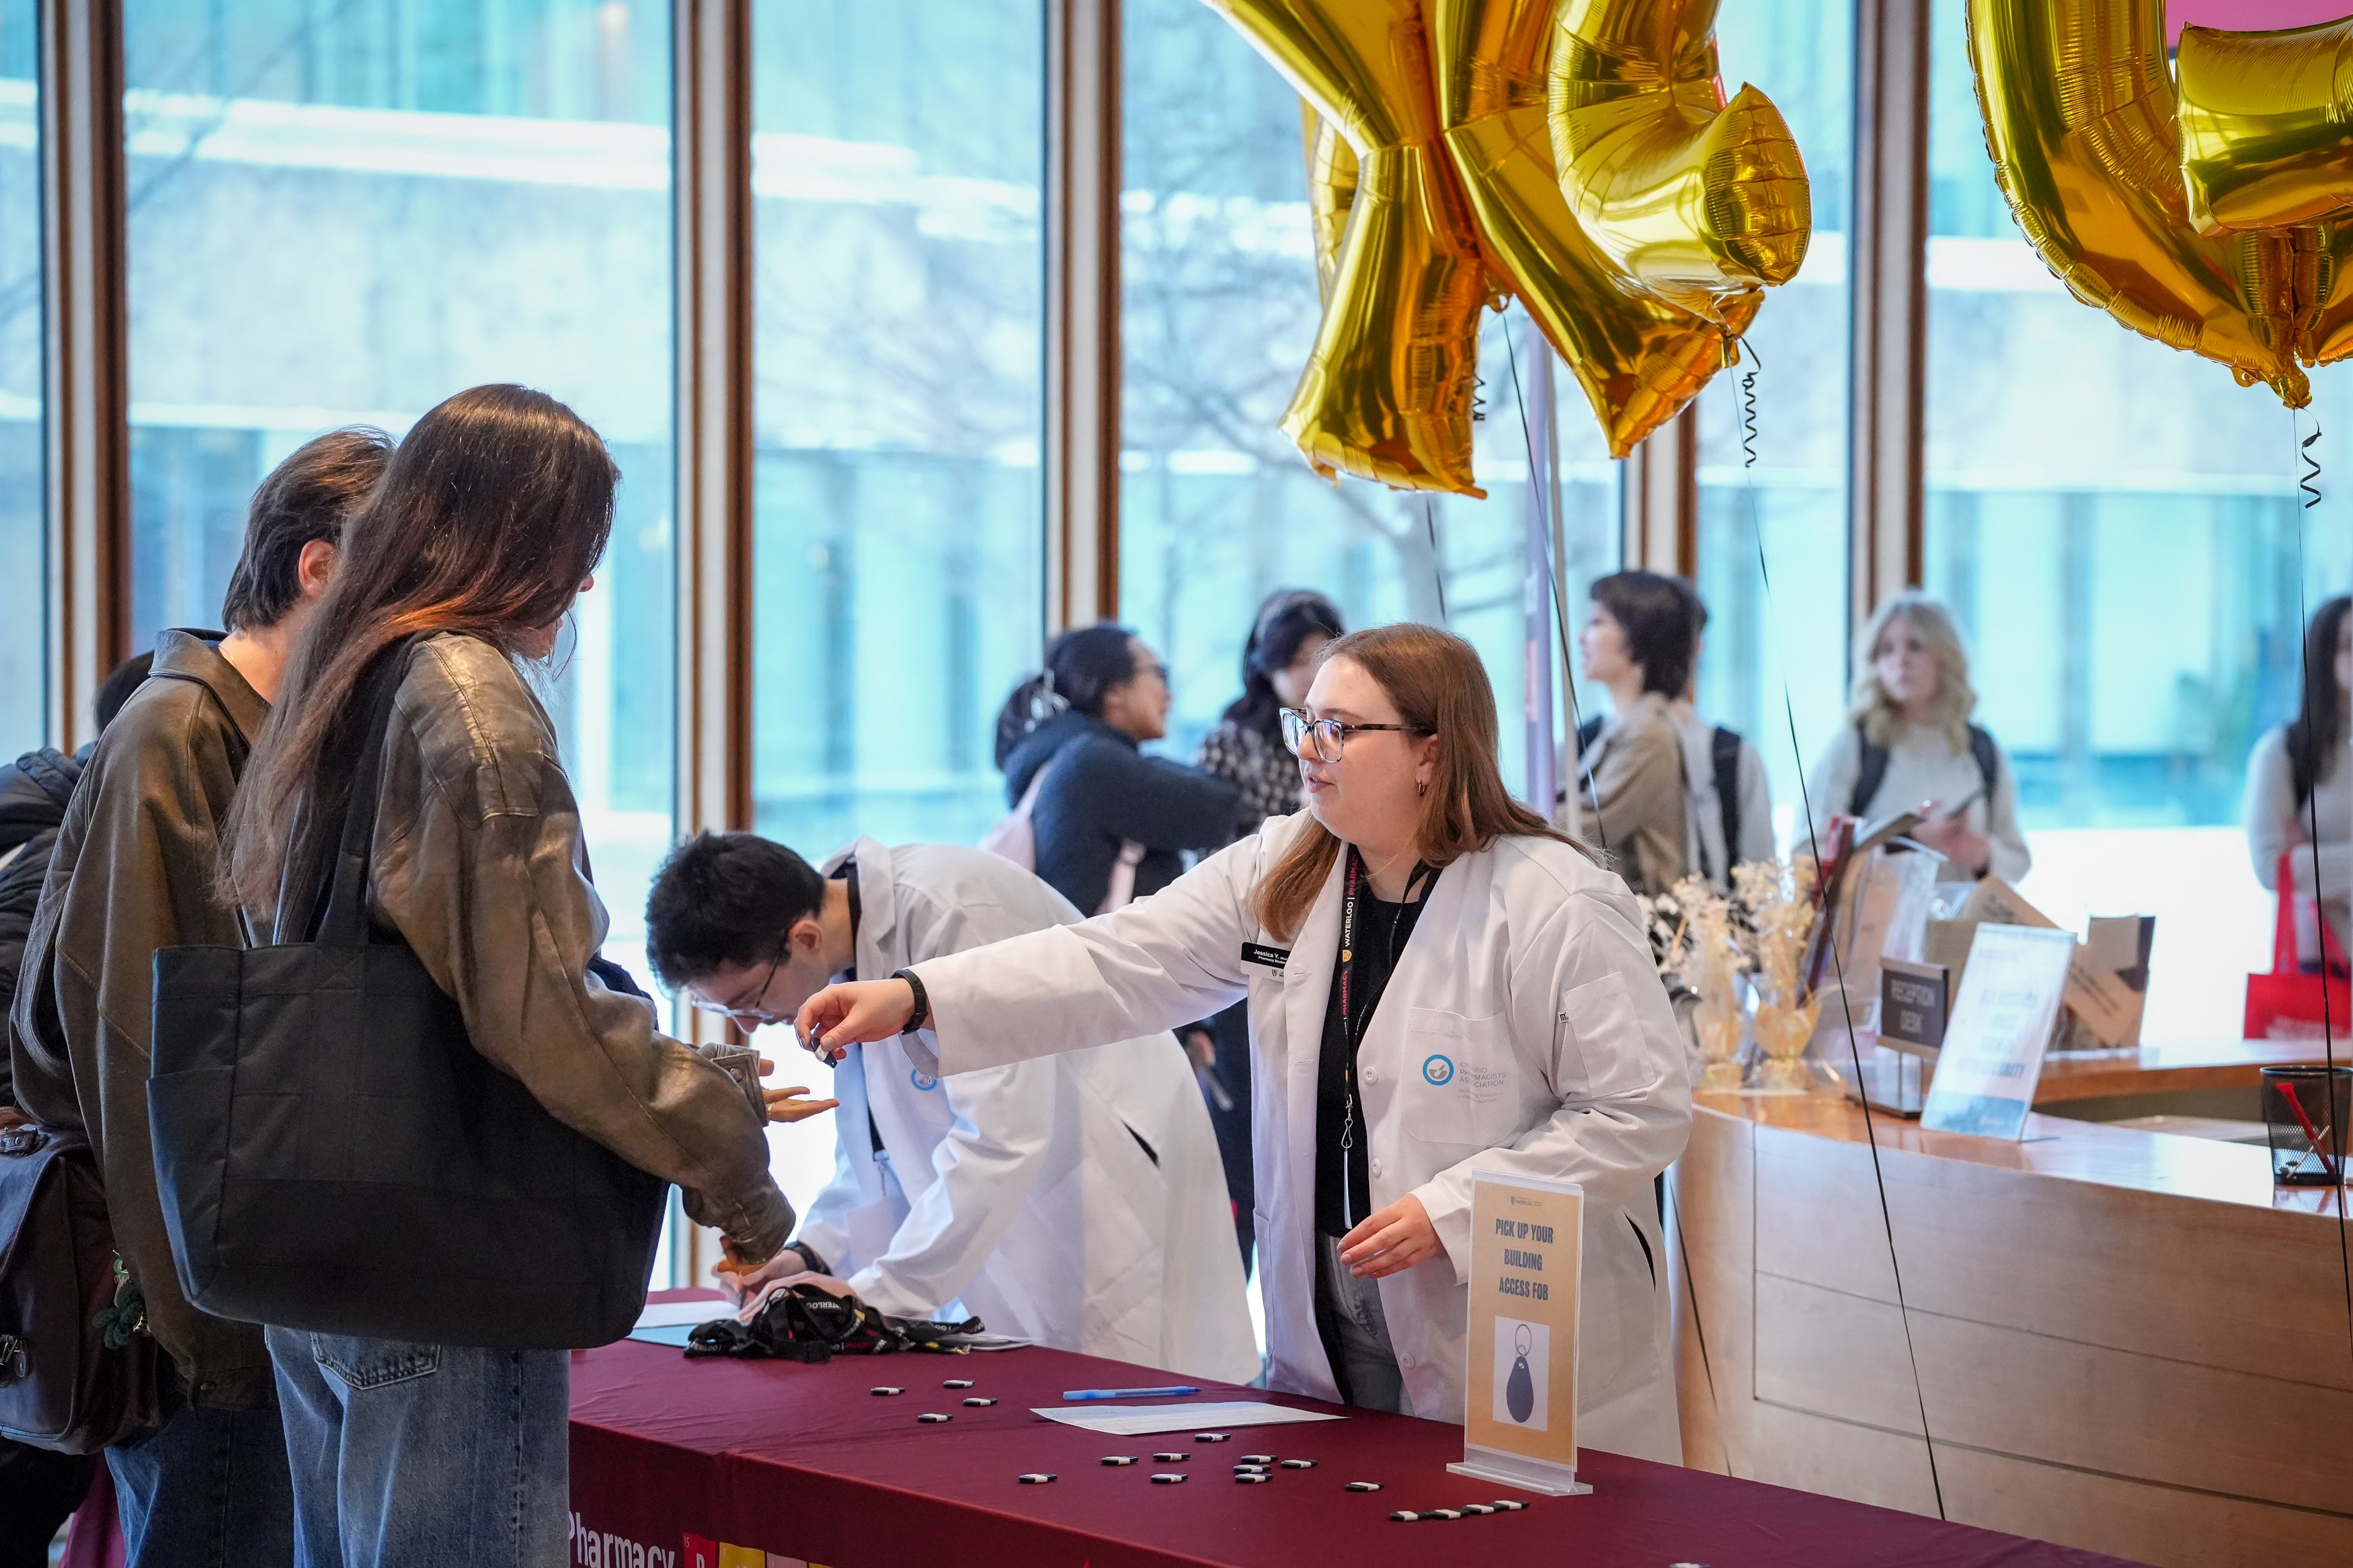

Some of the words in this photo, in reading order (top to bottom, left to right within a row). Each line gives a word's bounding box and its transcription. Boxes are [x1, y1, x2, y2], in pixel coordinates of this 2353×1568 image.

[1345, 901, 1353, 947] WATERLOO
[1349, 856, 1358, 896] PHARMAC
[1254, 950, 1273, 958] Jessica
[1460, 1061, 1488, 1073] ORIO
[1460, 1069, 1507, 1081] PHMACISTS
[1495, 1219, 1515, 1238] PICK
[1517, 1222, 1529, 1239] UP
[1531, 1224, 1554, 1244] YOUR
[1504, 1248, 1543, 1272] BUILDING
[1499, 1276, 1530, 1298] ACCESS
[1532, 1282, 1549, 1301] FOB
[684, 1536, 690, 1549] 15
